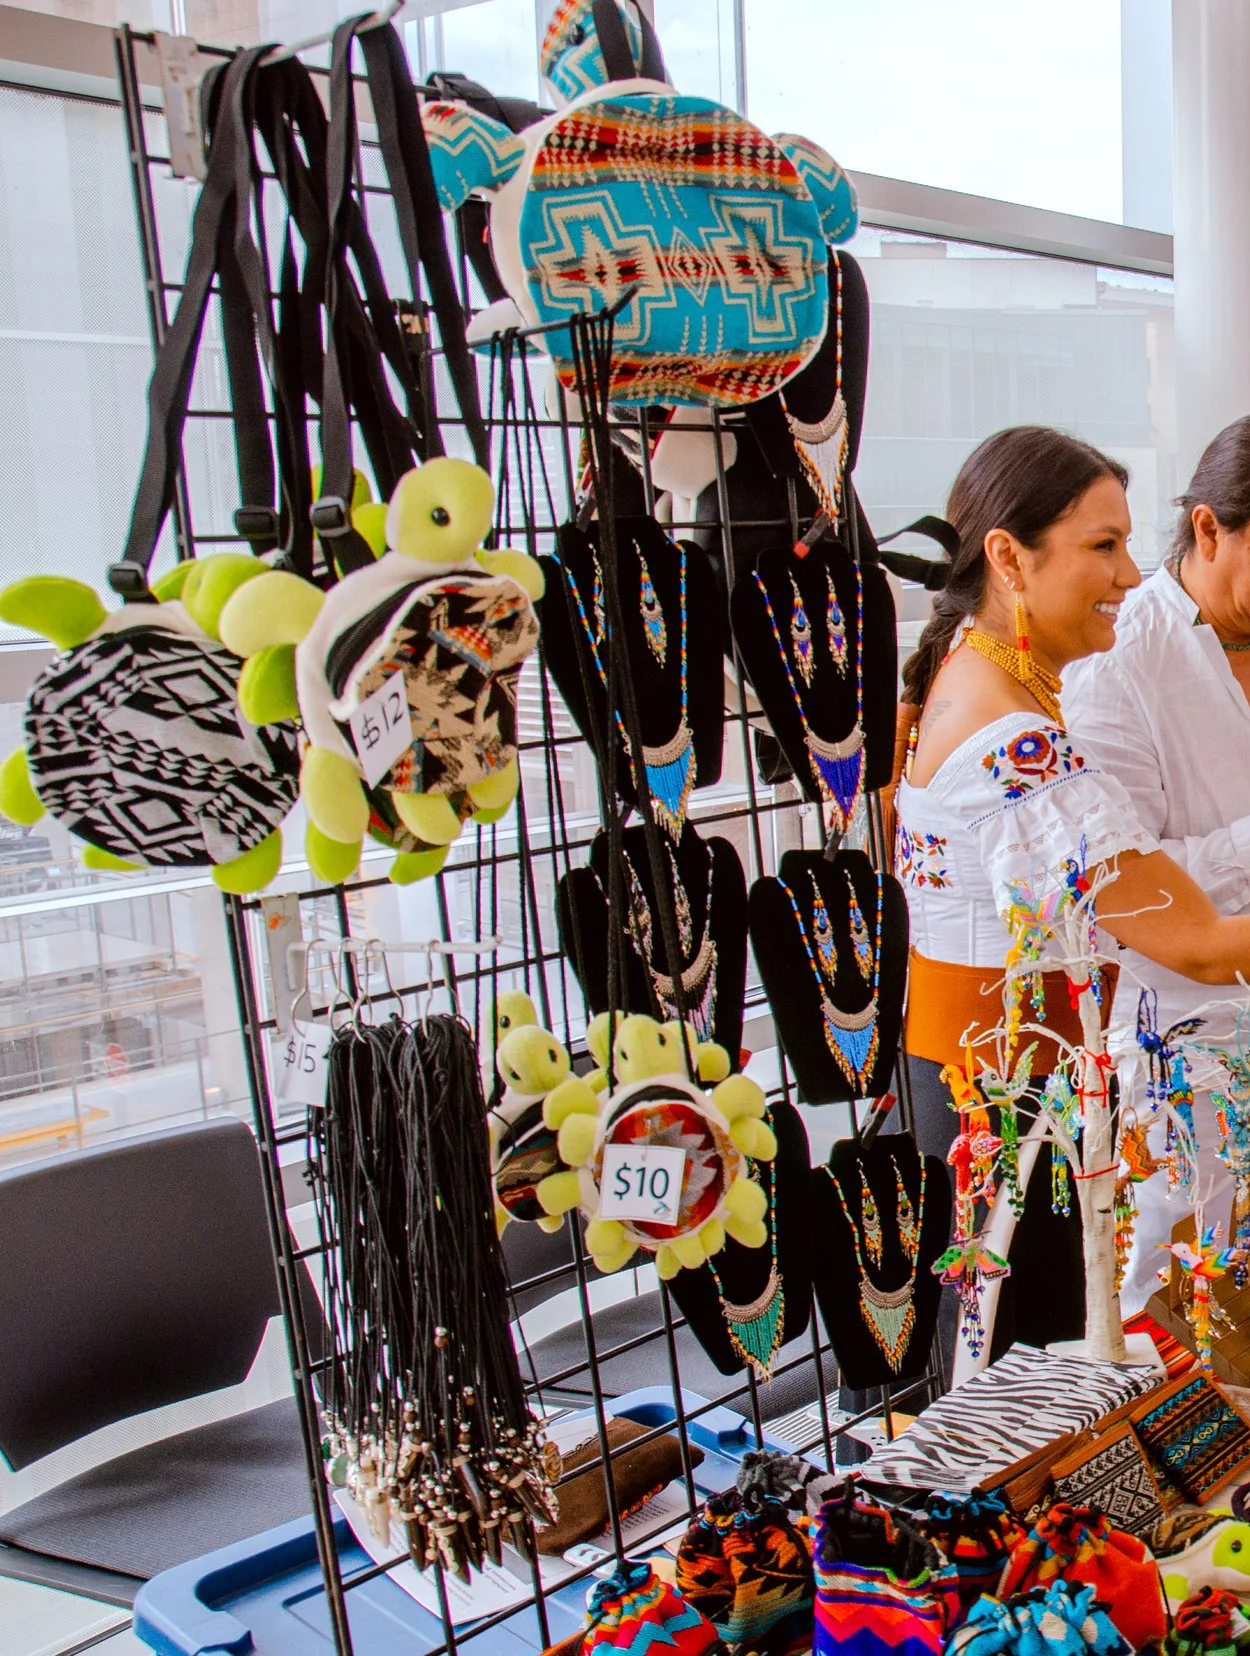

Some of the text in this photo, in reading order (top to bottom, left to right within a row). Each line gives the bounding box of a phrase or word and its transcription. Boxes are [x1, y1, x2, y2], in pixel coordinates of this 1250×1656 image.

[361, 691, 404, 751] $12
[283, 1035, 317, 1074] $15
[613, 1161, 670, 1201] $10
